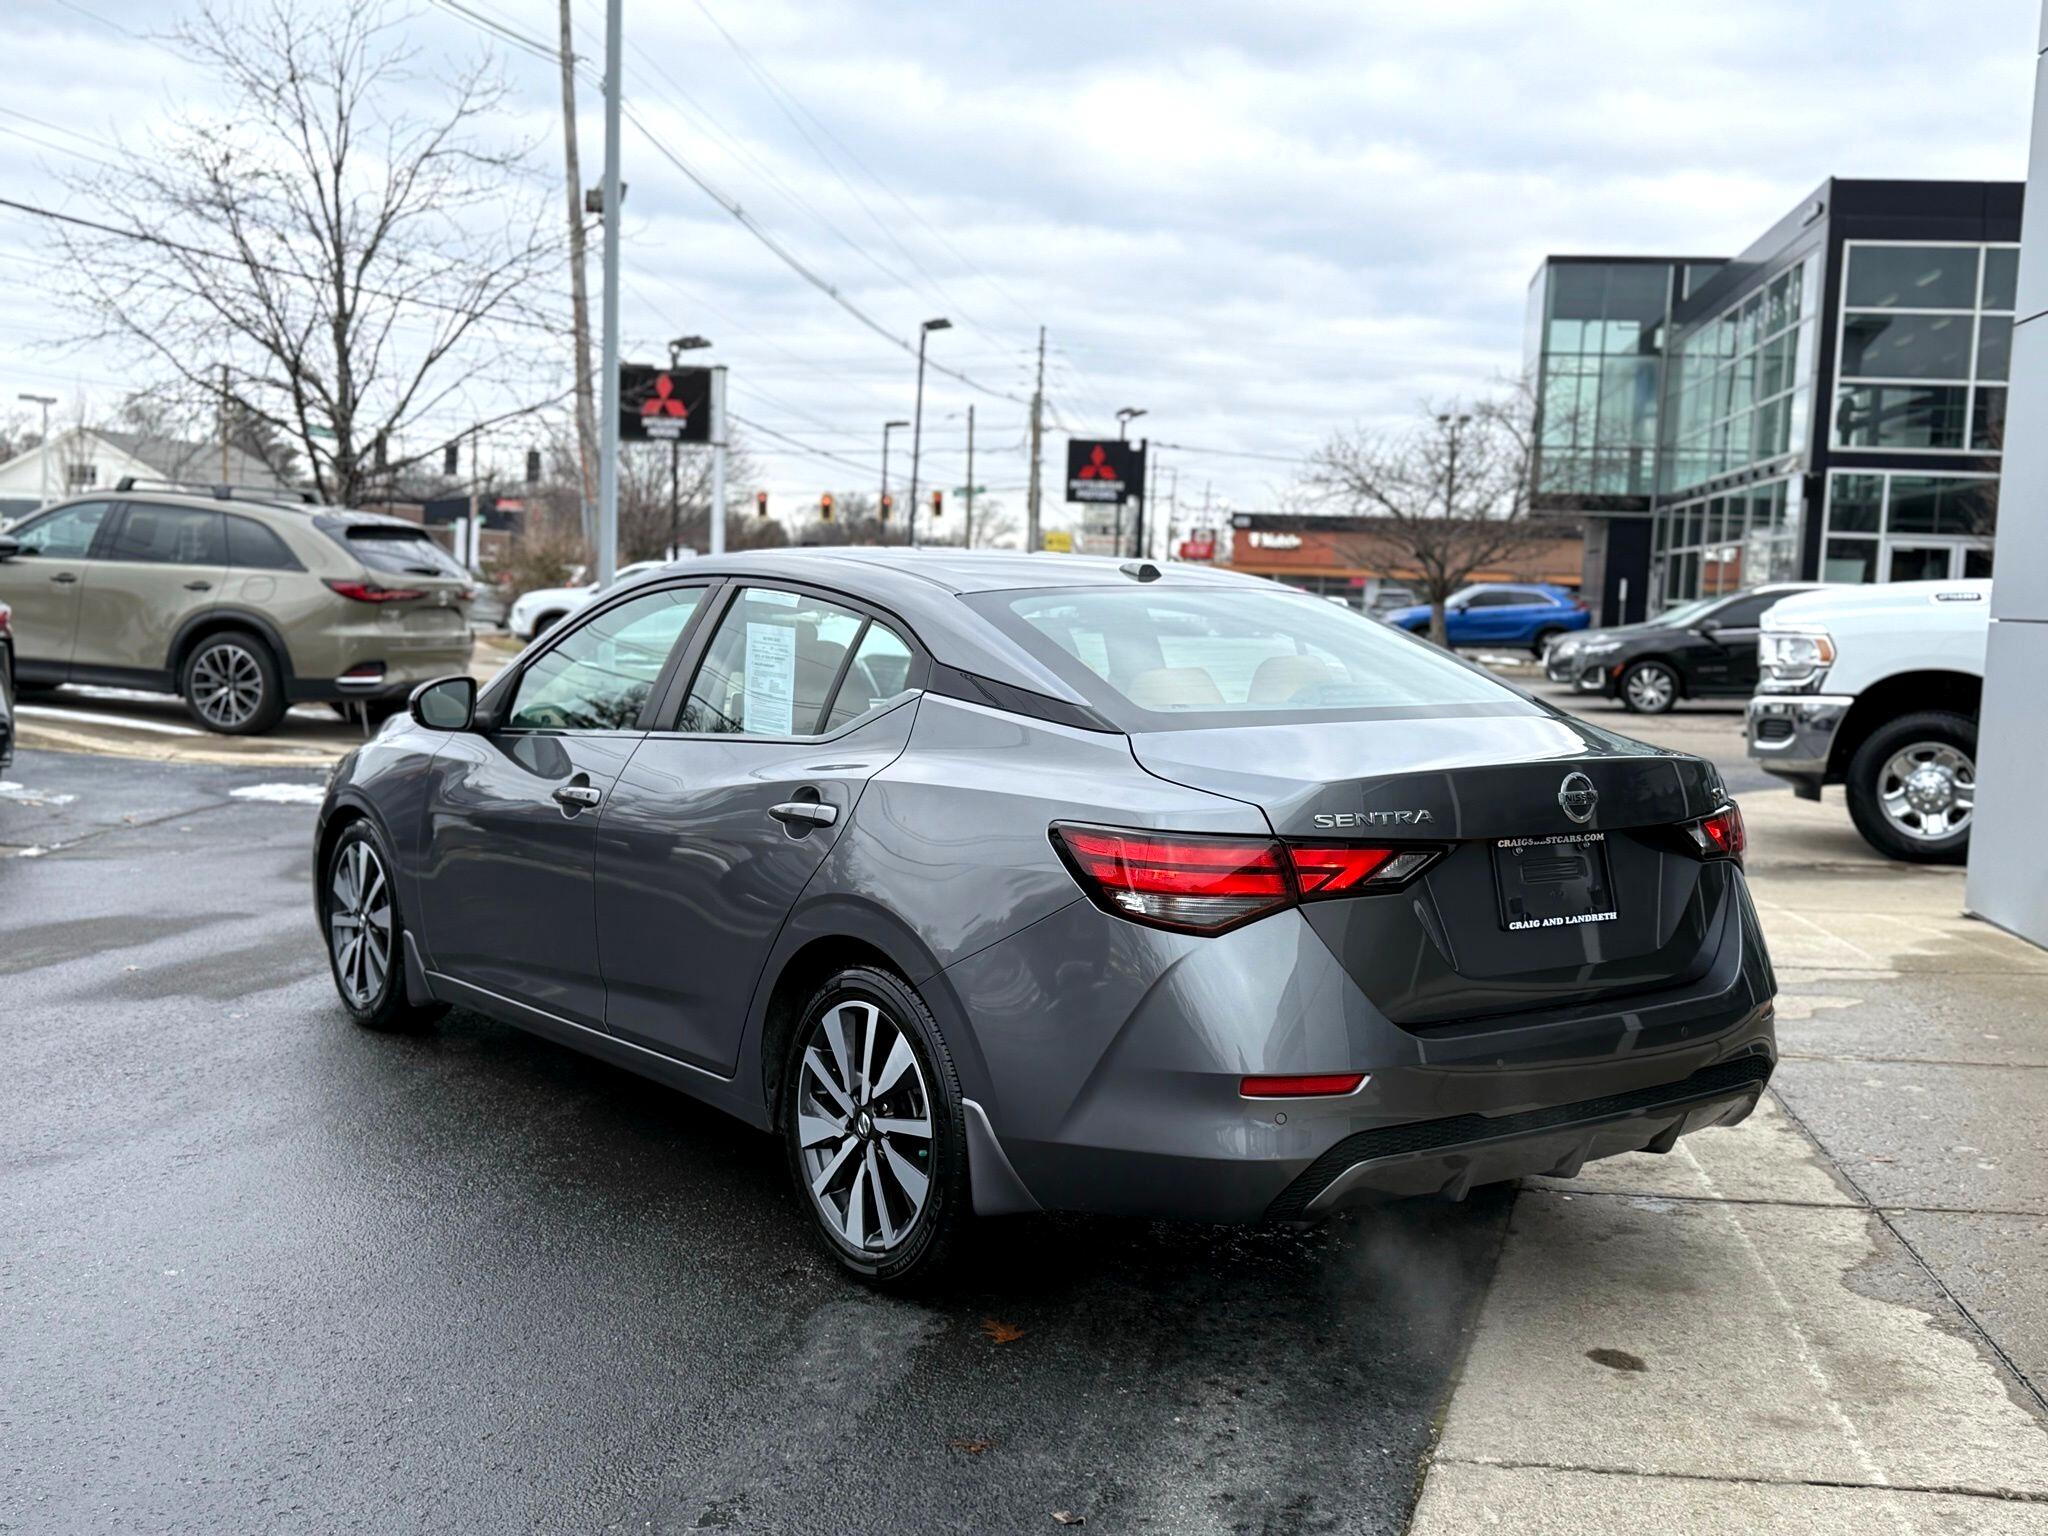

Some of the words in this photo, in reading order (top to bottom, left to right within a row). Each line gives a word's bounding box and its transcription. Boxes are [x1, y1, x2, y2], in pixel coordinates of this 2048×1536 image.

[1314, 809, 1434, 828] SENTRA
[1497, 833, 1605, 848] CRAIGSSTCARS.COM
[1508, 920, 1541, 930] CRAIG
[1542, 917, 1564, 927] AND
[1565, 911, 1618, 925] LANDRETH
